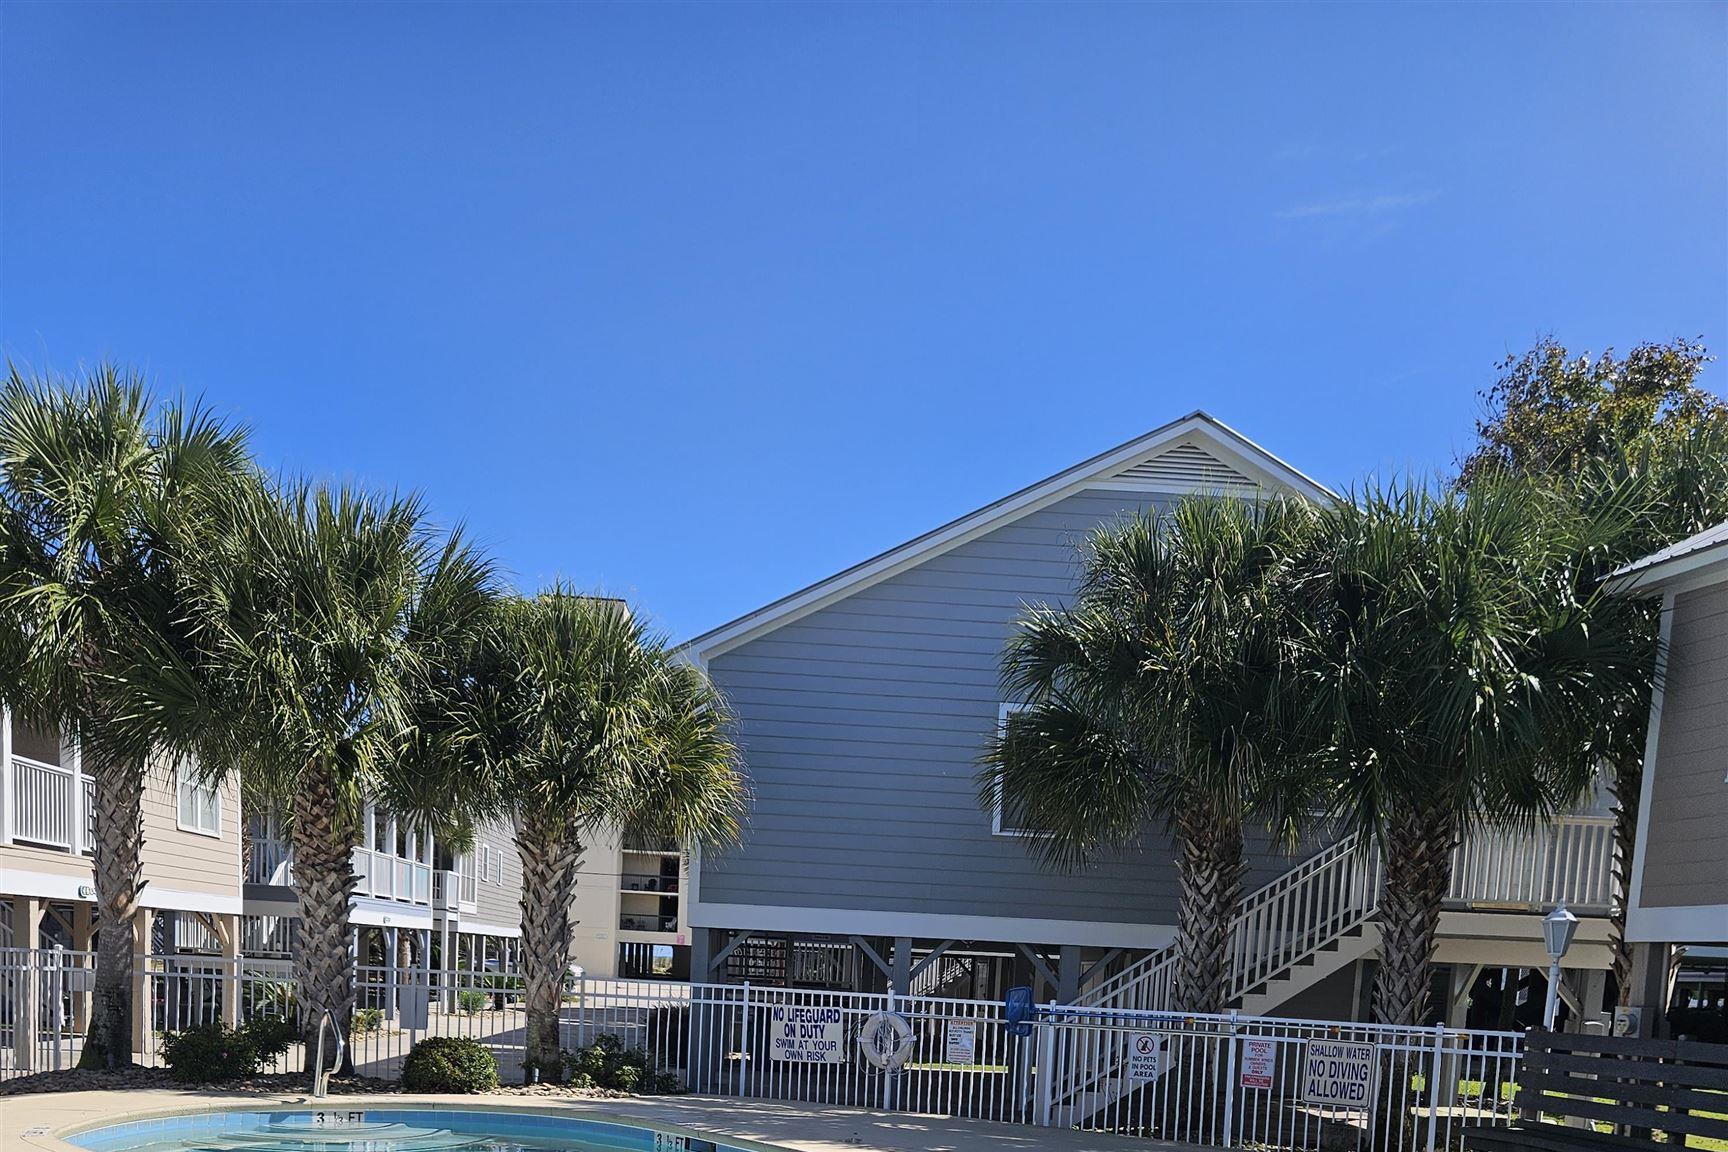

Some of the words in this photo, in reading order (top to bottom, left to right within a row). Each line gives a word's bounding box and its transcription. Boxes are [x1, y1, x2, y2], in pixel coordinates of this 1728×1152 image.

[773, 1007, 784, 1021] NO
[788, 1009, 840, 1023] LIFEGUARD
[784, 1023, 796, 1038] ON
[801, 1025, 825, 1039] DUTY
[776, 1038, 795, 1049] SWIM
[798, 1040, 808, 1050] AT
[813, 1041, 837, 1051] YOUR
[1310, 1044, 1344, 1059] SHALLOW
[1347, 1047, 1371, 1060] WATER
[785, 1050, 803, 1060] OWN
[807, 1052, 826, 1062] RISK
[1308, 1059, 1326, 1077] NO
[1329, 1061, 1368, 1082] DIVING
[1308, 1079, 1365, 1100] ALLOWED
[317, 1112, 325, 1123] 3
[349, 1111, 364, 1122] FT
[675, 1137, 684, 1149] FT
